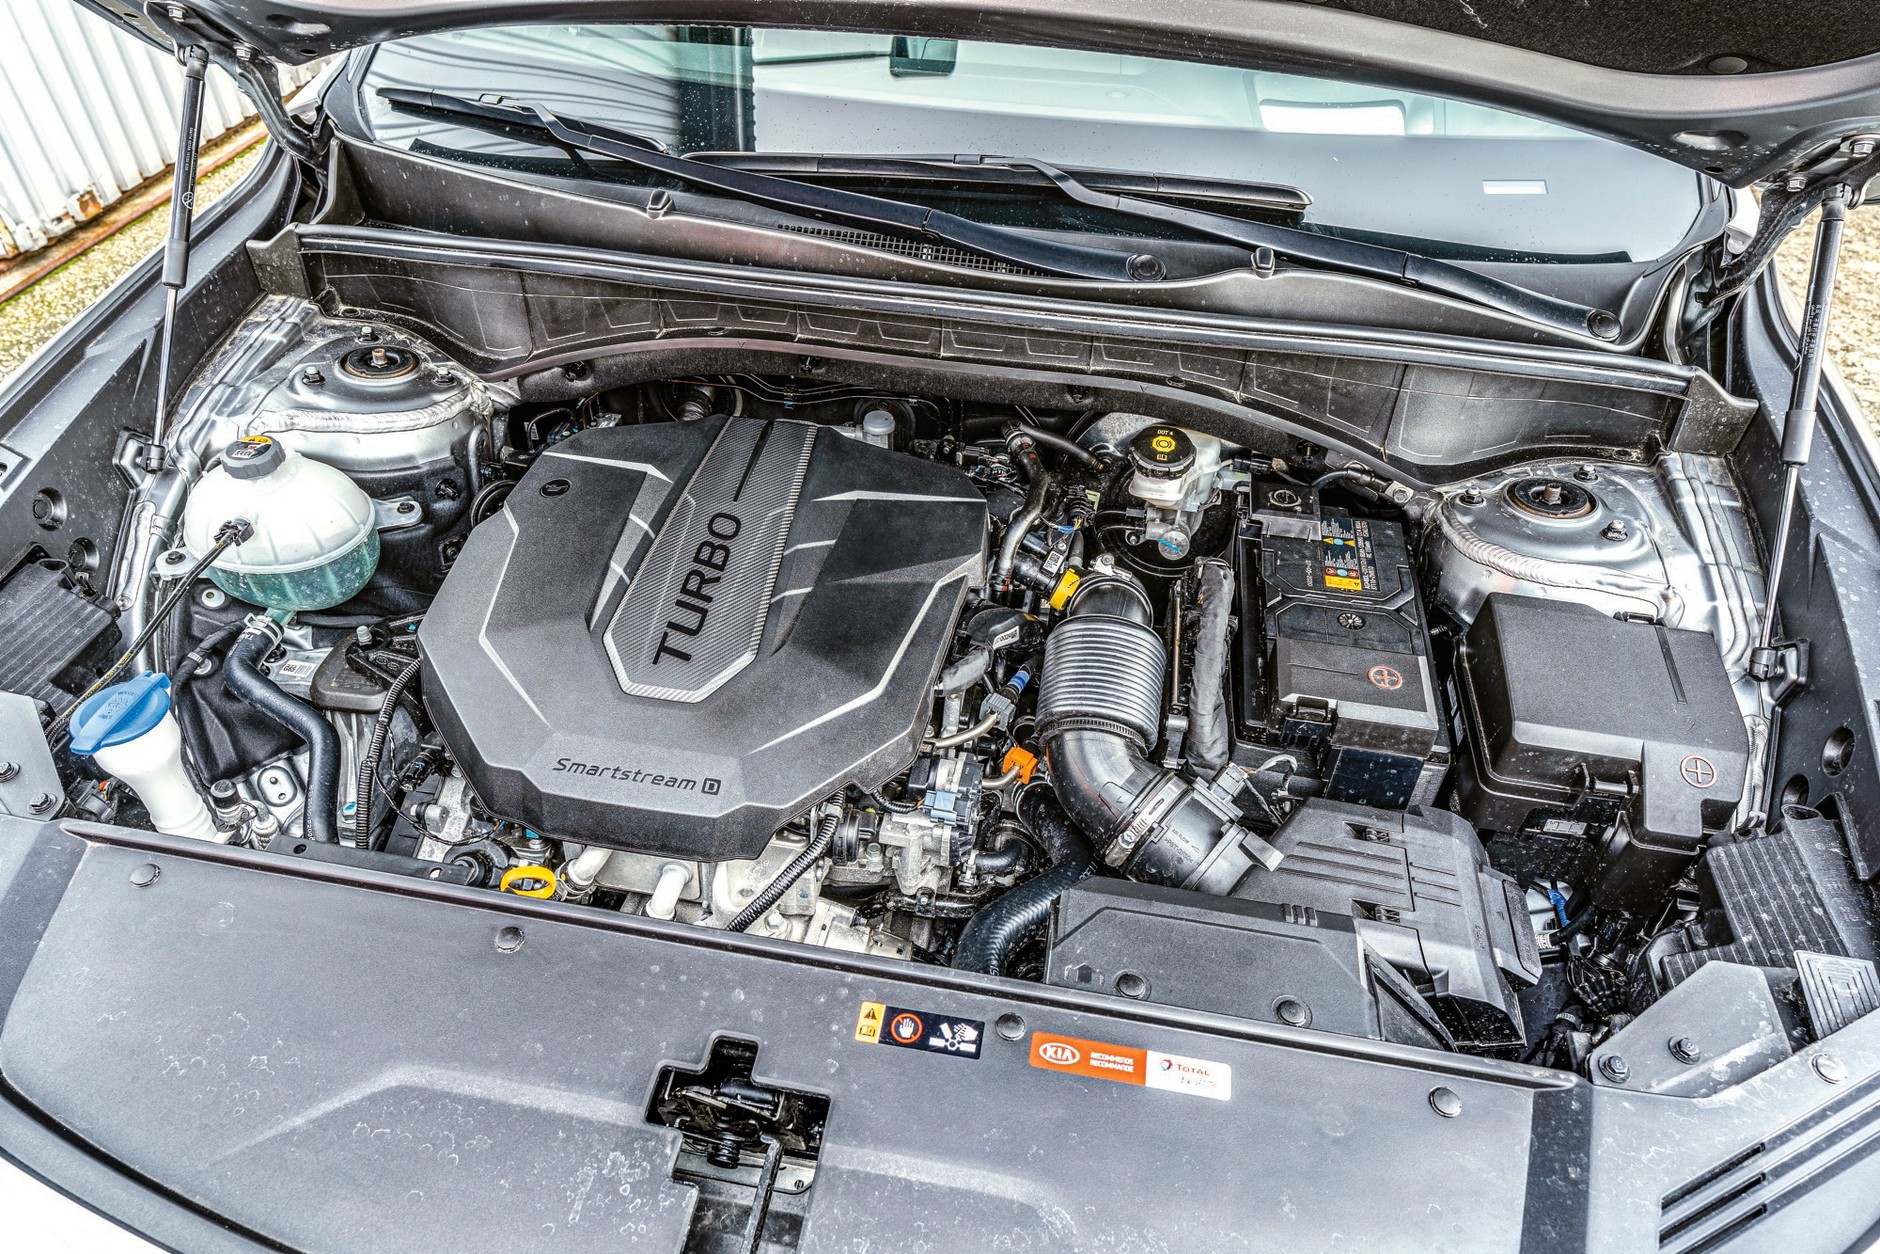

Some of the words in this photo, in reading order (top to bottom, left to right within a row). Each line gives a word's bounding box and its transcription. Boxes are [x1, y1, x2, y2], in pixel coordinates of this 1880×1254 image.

[652, 512, 742, 665] TURBO
[552, 757, 697, 790] Smartstream
[1044, 1045, 1073, 1062] KIA
[1090, 1051, 1134, 1066] RECOMMENDS
[1176, 1063, 1211, 1077] TOTAL
